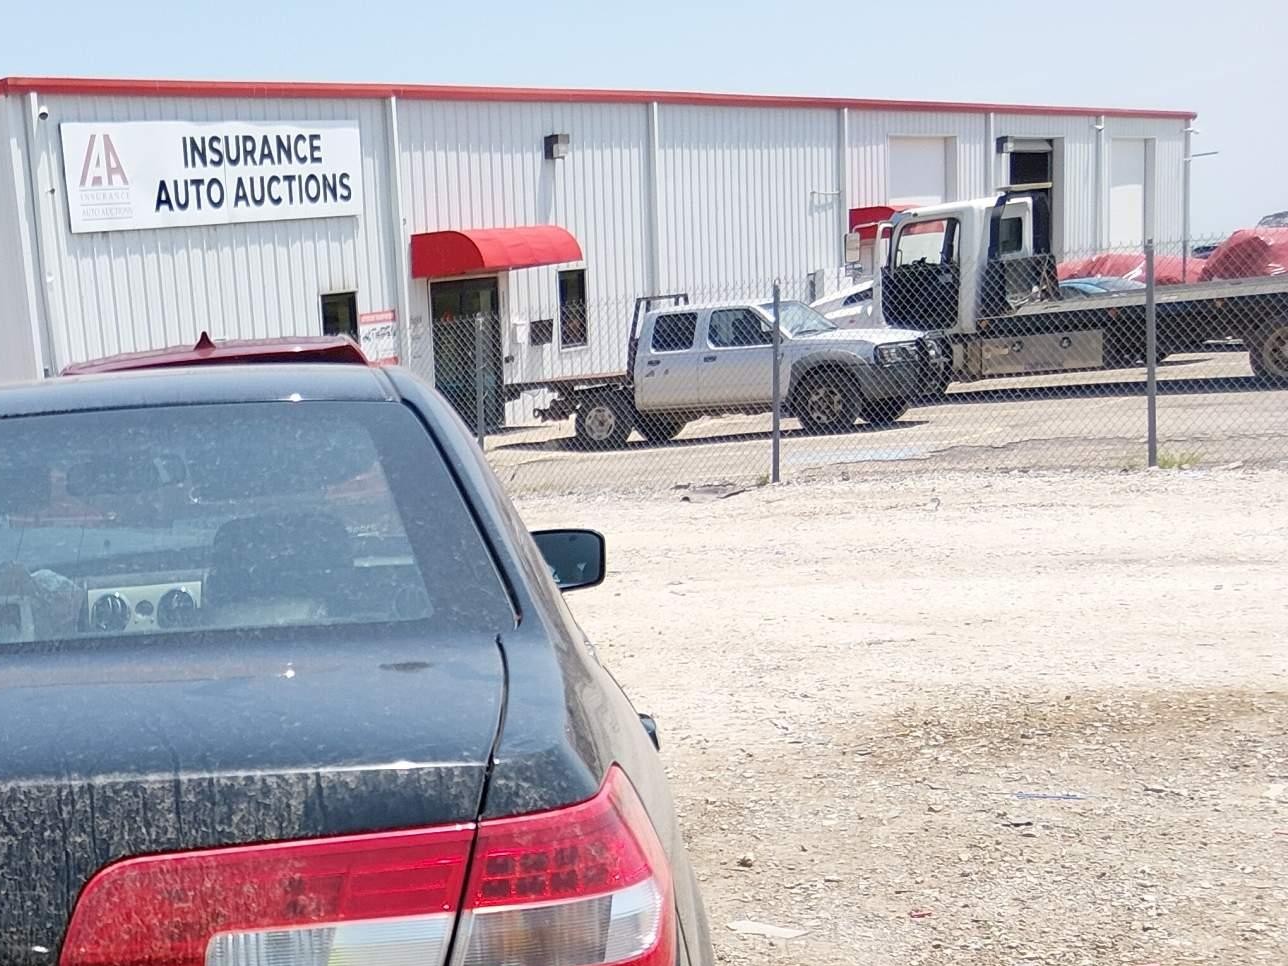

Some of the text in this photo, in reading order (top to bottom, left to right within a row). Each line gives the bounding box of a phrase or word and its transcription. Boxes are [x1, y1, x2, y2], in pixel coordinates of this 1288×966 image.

[182, 133, 323, 169] INSURANCE
[155, 172, 353, 213] AUTO AUCTIONS
